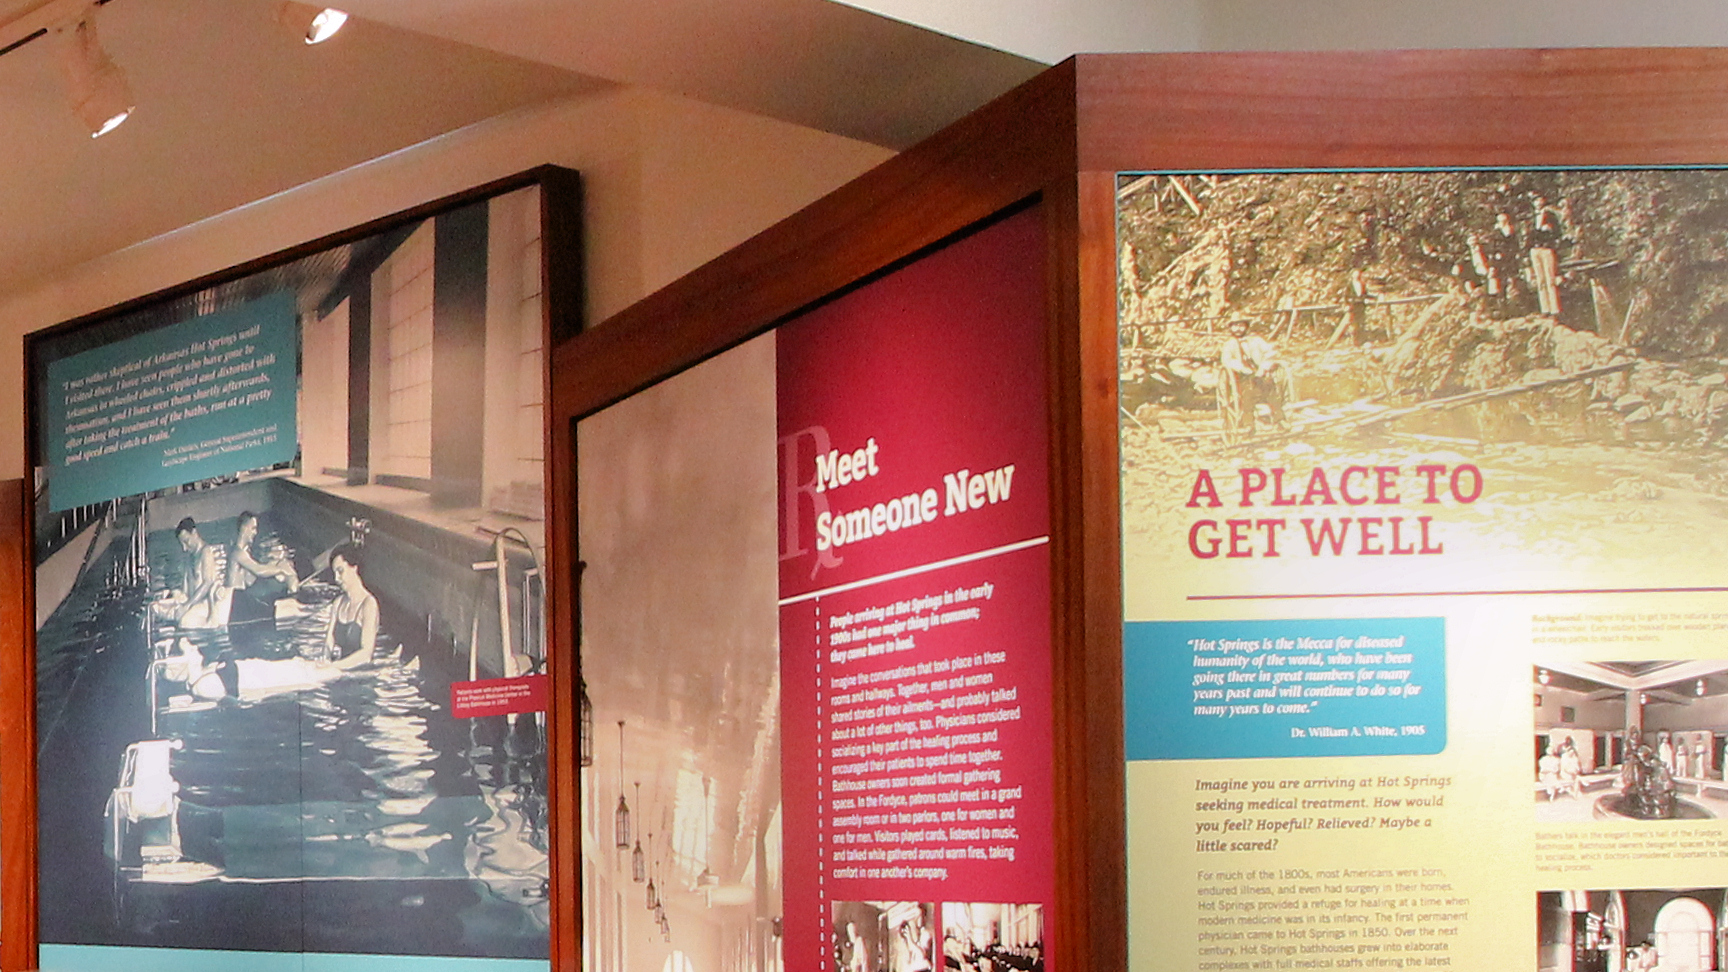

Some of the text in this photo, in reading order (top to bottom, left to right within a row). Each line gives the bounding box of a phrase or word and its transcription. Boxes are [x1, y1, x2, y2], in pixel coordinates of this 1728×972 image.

[816, 438, 879, 492] Meet
[1186, 464, 1483, 508] A PLACE TO
[817, 465, 1014, 551] Someone New
[1188, 516, 1443, 559] GET WELL
[830, 584, 994, 628] People arriving at Hot Springs in the early
[830, 631, 851, 645] 1900s
[852, 627, 867, 640] had
[868, 627, 881, 637] one
[883, 622, 906, 636] major
[907, 617, 929, 629] thing
[931, 614, 939, 624] in
[831, 650, 847, 663] they
[868, 644, 884, 655] here
[886, 641, 894, 652] to
[895, 637, 915, 650] heal.
[1218, 639, 1260, 653] Springs
[1263, 639, 1273, 649] is
[1276, 638, 1294, 649] the
[1296, 638, 1333, 649] Mecca
[1336, 637, 1353, 652] for
[1355, 636, 1405, 648] diseased
[1193, 652, 1412, 669] humanity of the world, who have been
[1192, 669, 1410, 686] going there in great numbers for many
[1194, 684, 1421, 702] years past and will continue to do so for
[1194, 706, 1227, 717] many
[1229, 705, 1259, 717] years
[1262, 703, 1275, 713] to
[1291, 728, 1306, 737] Dr.
[1309, 727, 1348, 737] William
[1351, 727, 1361, 736] A.
[1364, 726, 1398, 736] White,
[1195, 776, 1452, 793] Imagine you are arriving at Hot Springs
[1196, 796, 1444, 812] seeking medical treatment. How would
[1196, 823, 1220, 833] you
[1223, 819, 1253, 833] feel?
[1256, 818, 1313, 832] Hopeful?
[1317, 817, 1376, 828] Relieved?
[1380, 816, 1420, 830] Maybe
[1196, 839, 1279, 851] little scared?
[833, 868, 858, 878] comfort
[859, 868, 866, 878] in
[868, 870, 879, 878] one
[914, 870, 948, 880] company.
[1198, 871, 1213, 880] For
[1216, 871, 1243, 880] much
[1246, 871, 1256, 879] of
[1259, 870, 1275, 879] the
[1279, 870, 1313, 880] 1800s,
[1317, 870, 1339, 878] most
[1343, 869, 1393, 878] Americans
